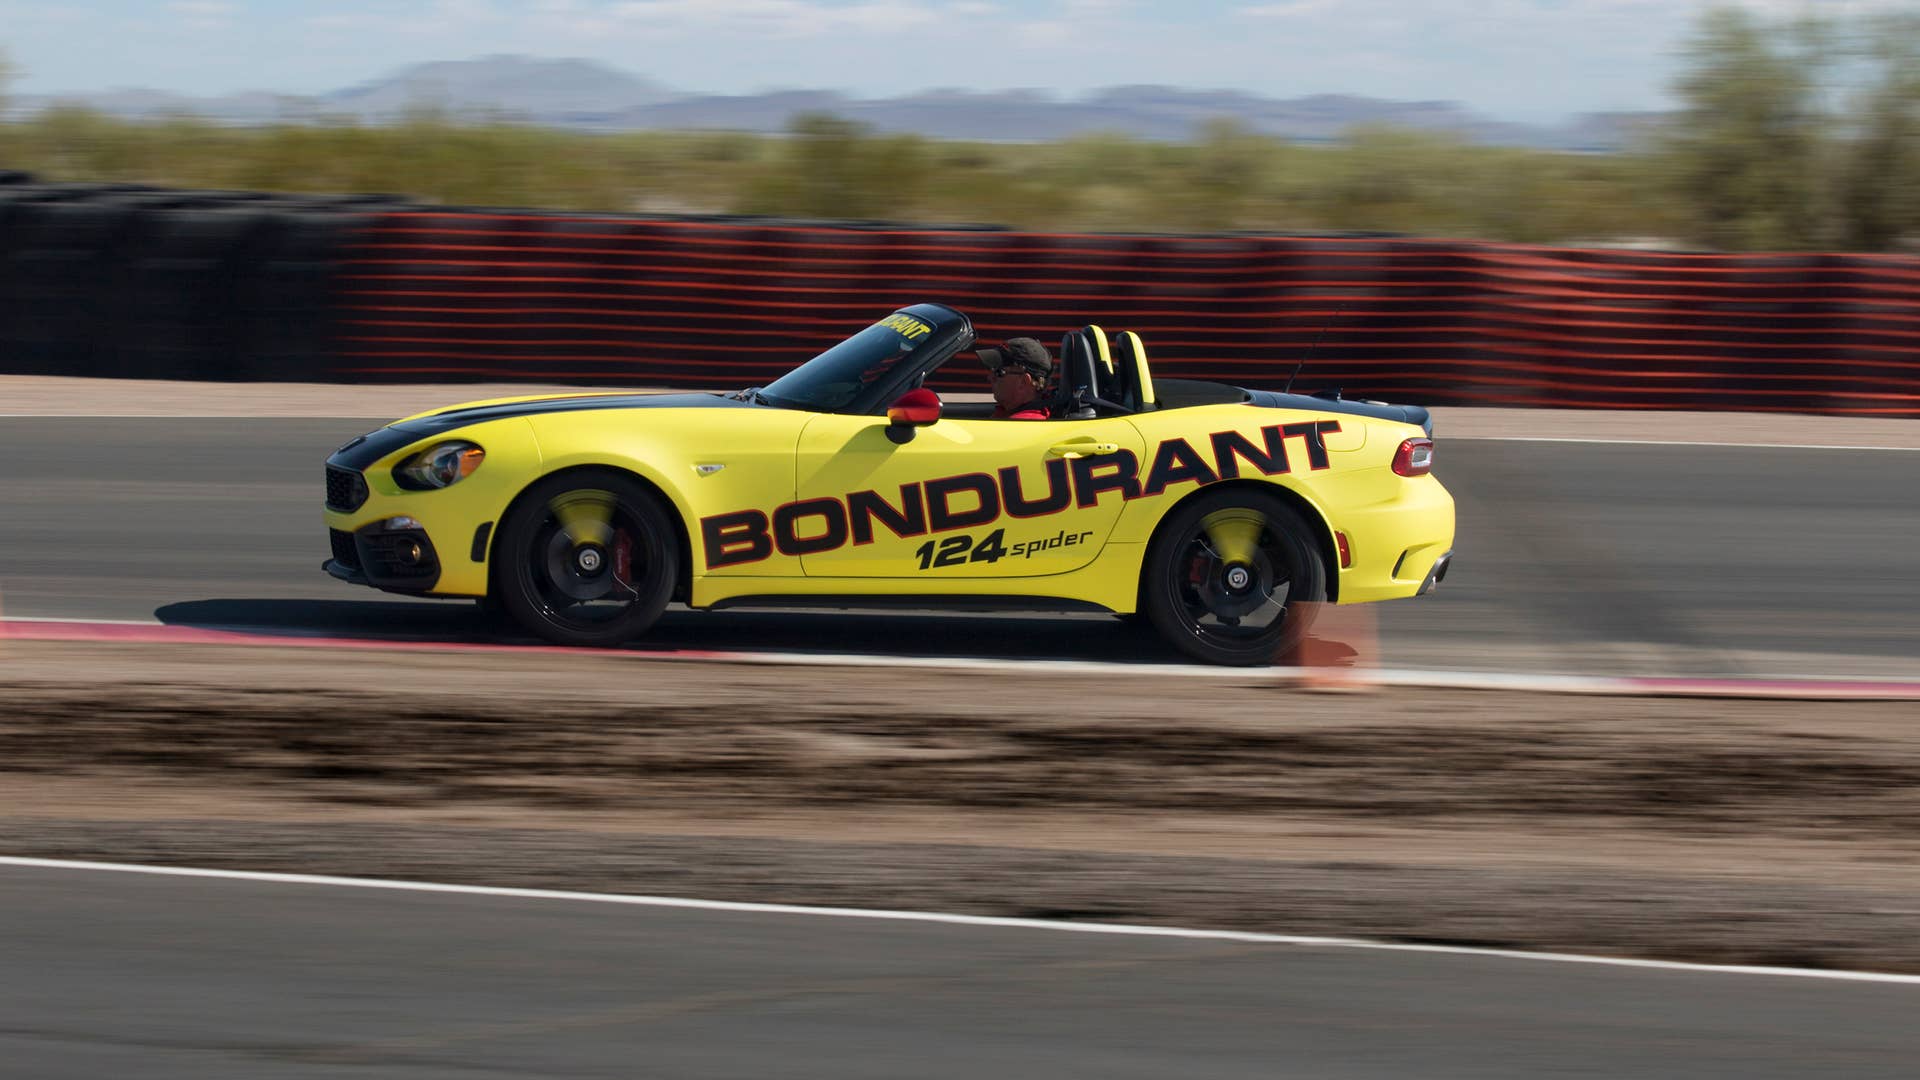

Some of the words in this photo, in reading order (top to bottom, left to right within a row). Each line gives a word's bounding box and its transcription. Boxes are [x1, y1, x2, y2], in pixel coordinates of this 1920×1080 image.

[700, 420, 1342, 571] BONDURANT
[915, 528, 1008, 570] 124
[1010, 530, 1093, 559] spider
